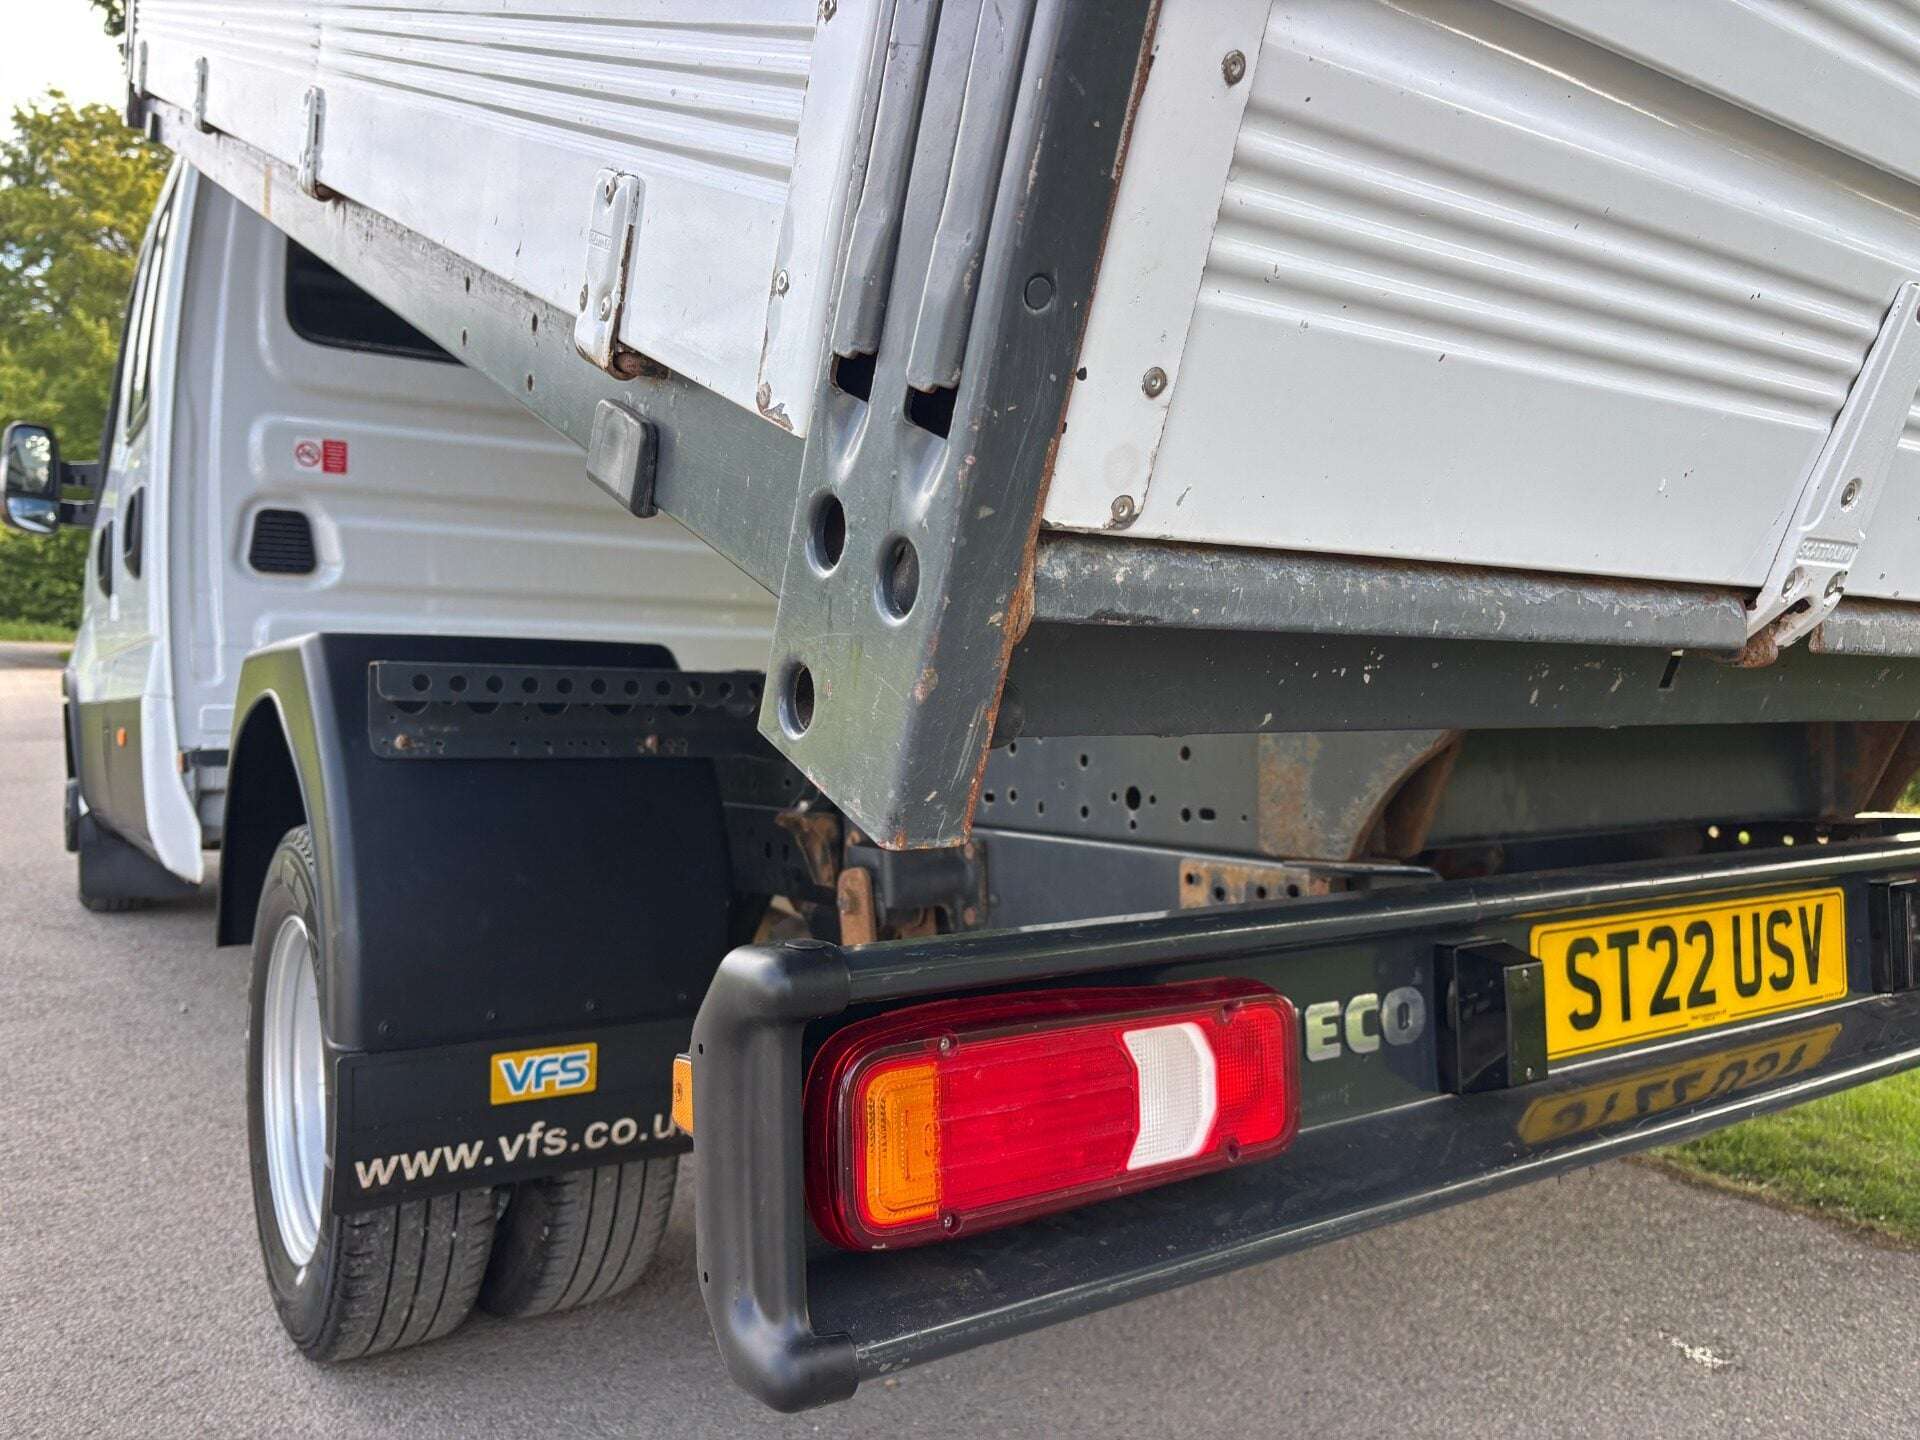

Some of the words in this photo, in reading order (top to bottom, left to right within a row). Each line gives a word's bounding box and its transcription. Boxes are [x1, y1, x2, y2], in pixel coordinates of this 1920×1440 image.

[1566, 920, 1717, 1031] ST22
[1731, 903, 1824, 998] USV
[1296, 986, 1427, 1062] ECO
[499, 1051, 590, 1095] VFS
[354, 1113, 685, 1189] www.vfs.co.u
